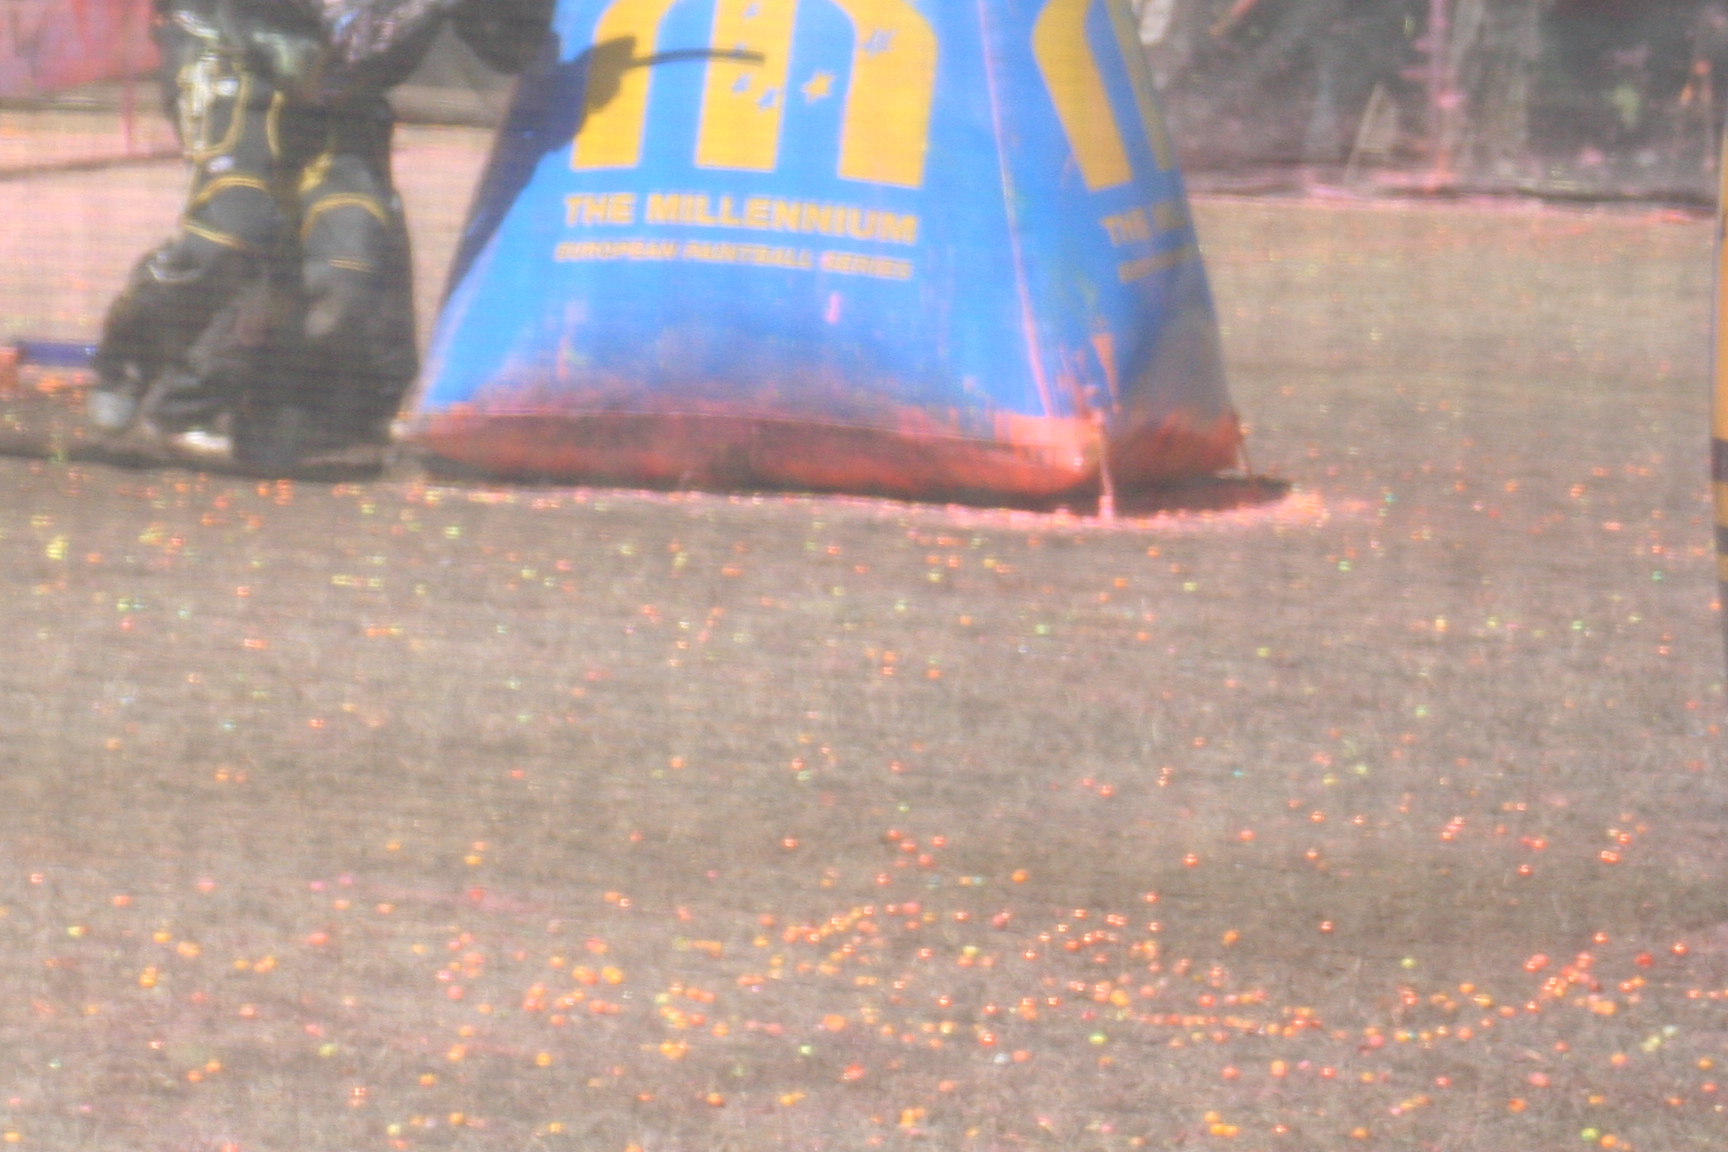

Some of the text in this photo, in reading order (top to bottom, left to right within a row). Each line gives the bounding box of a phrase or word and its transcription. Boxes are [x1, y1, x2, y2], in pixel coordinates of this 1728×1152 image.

[563, 192, 920, 246] THE MILLENNIUM
[555, 238, 915, 282] EUROPEAN PAINTBALL SERIES
